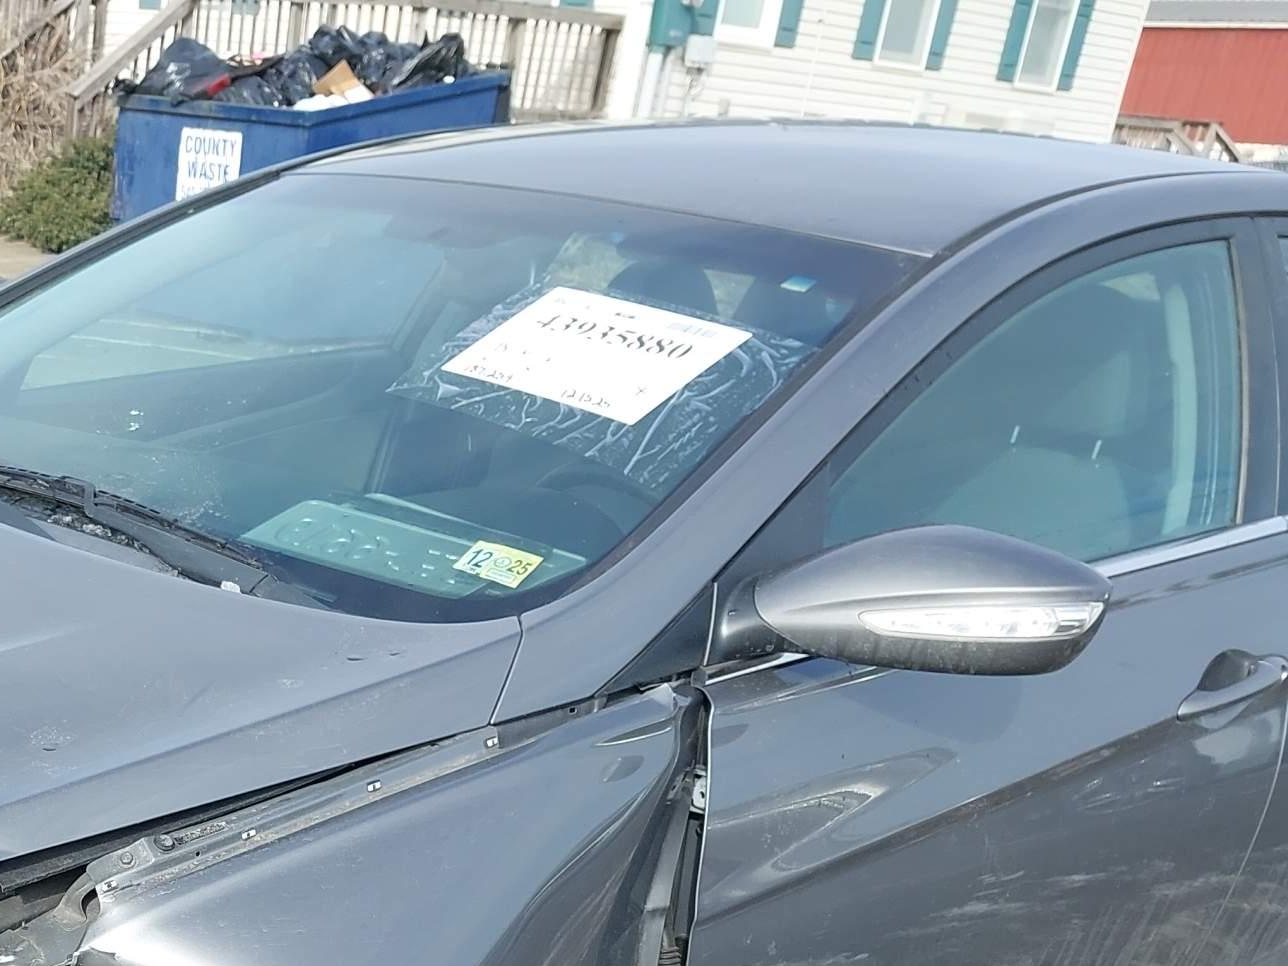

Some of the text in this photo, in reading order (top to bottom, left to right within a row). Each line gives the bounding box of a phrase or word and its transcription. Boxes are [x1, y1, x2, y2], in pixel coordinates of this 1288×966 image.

[184, 135, 237, 158] COUNTY
[187, 161, 230, 184] WASTE
[536, 314, 693, 360] 43935880
[467, 549, 493, 568] 12
[506, 559, 533, 576] 25
